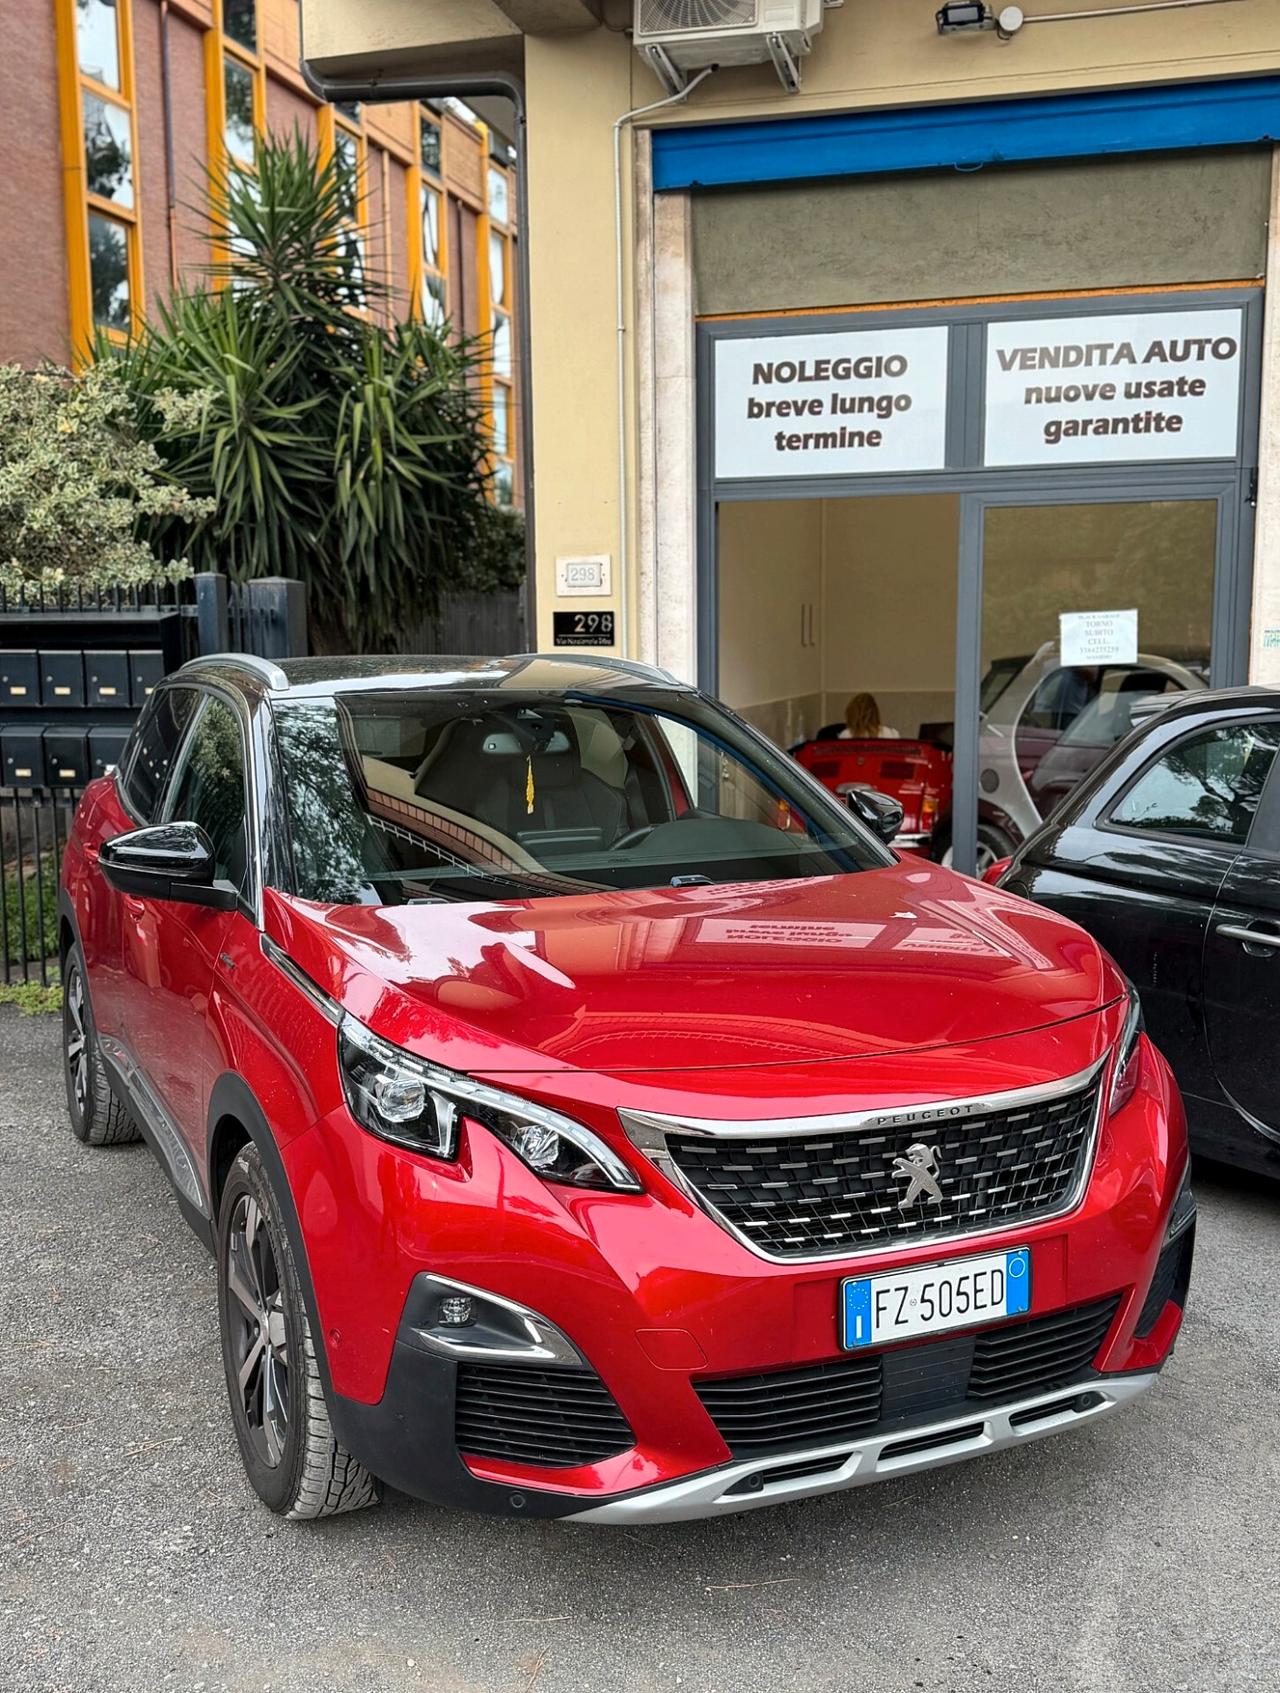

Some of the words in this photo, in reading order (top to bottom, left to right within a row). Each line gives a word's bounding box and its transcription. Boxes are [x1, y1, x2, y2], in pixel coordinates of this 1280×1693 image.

[996, 342, 1137, 372] VENDITA
[1141, 337, 1238, 364] AUTO
[752, 354, 908, 385] NOLEGGIO
[1024, 382, 1116, 405] nuove
[1123, 376, 1206, 399] usate
[747, 396, 824, 419] breve
[830, 392, 912, 419] lungo
[774, 426, 882, 451] termine
[1043, 411, 1184, 444] garantite
[570, 567, 595, 581] 298
[574, 614, 612, 632] 298
[877, 1104, 974, 1126] PEUGEOT
[875, 1285, 909, 1329] FZ
